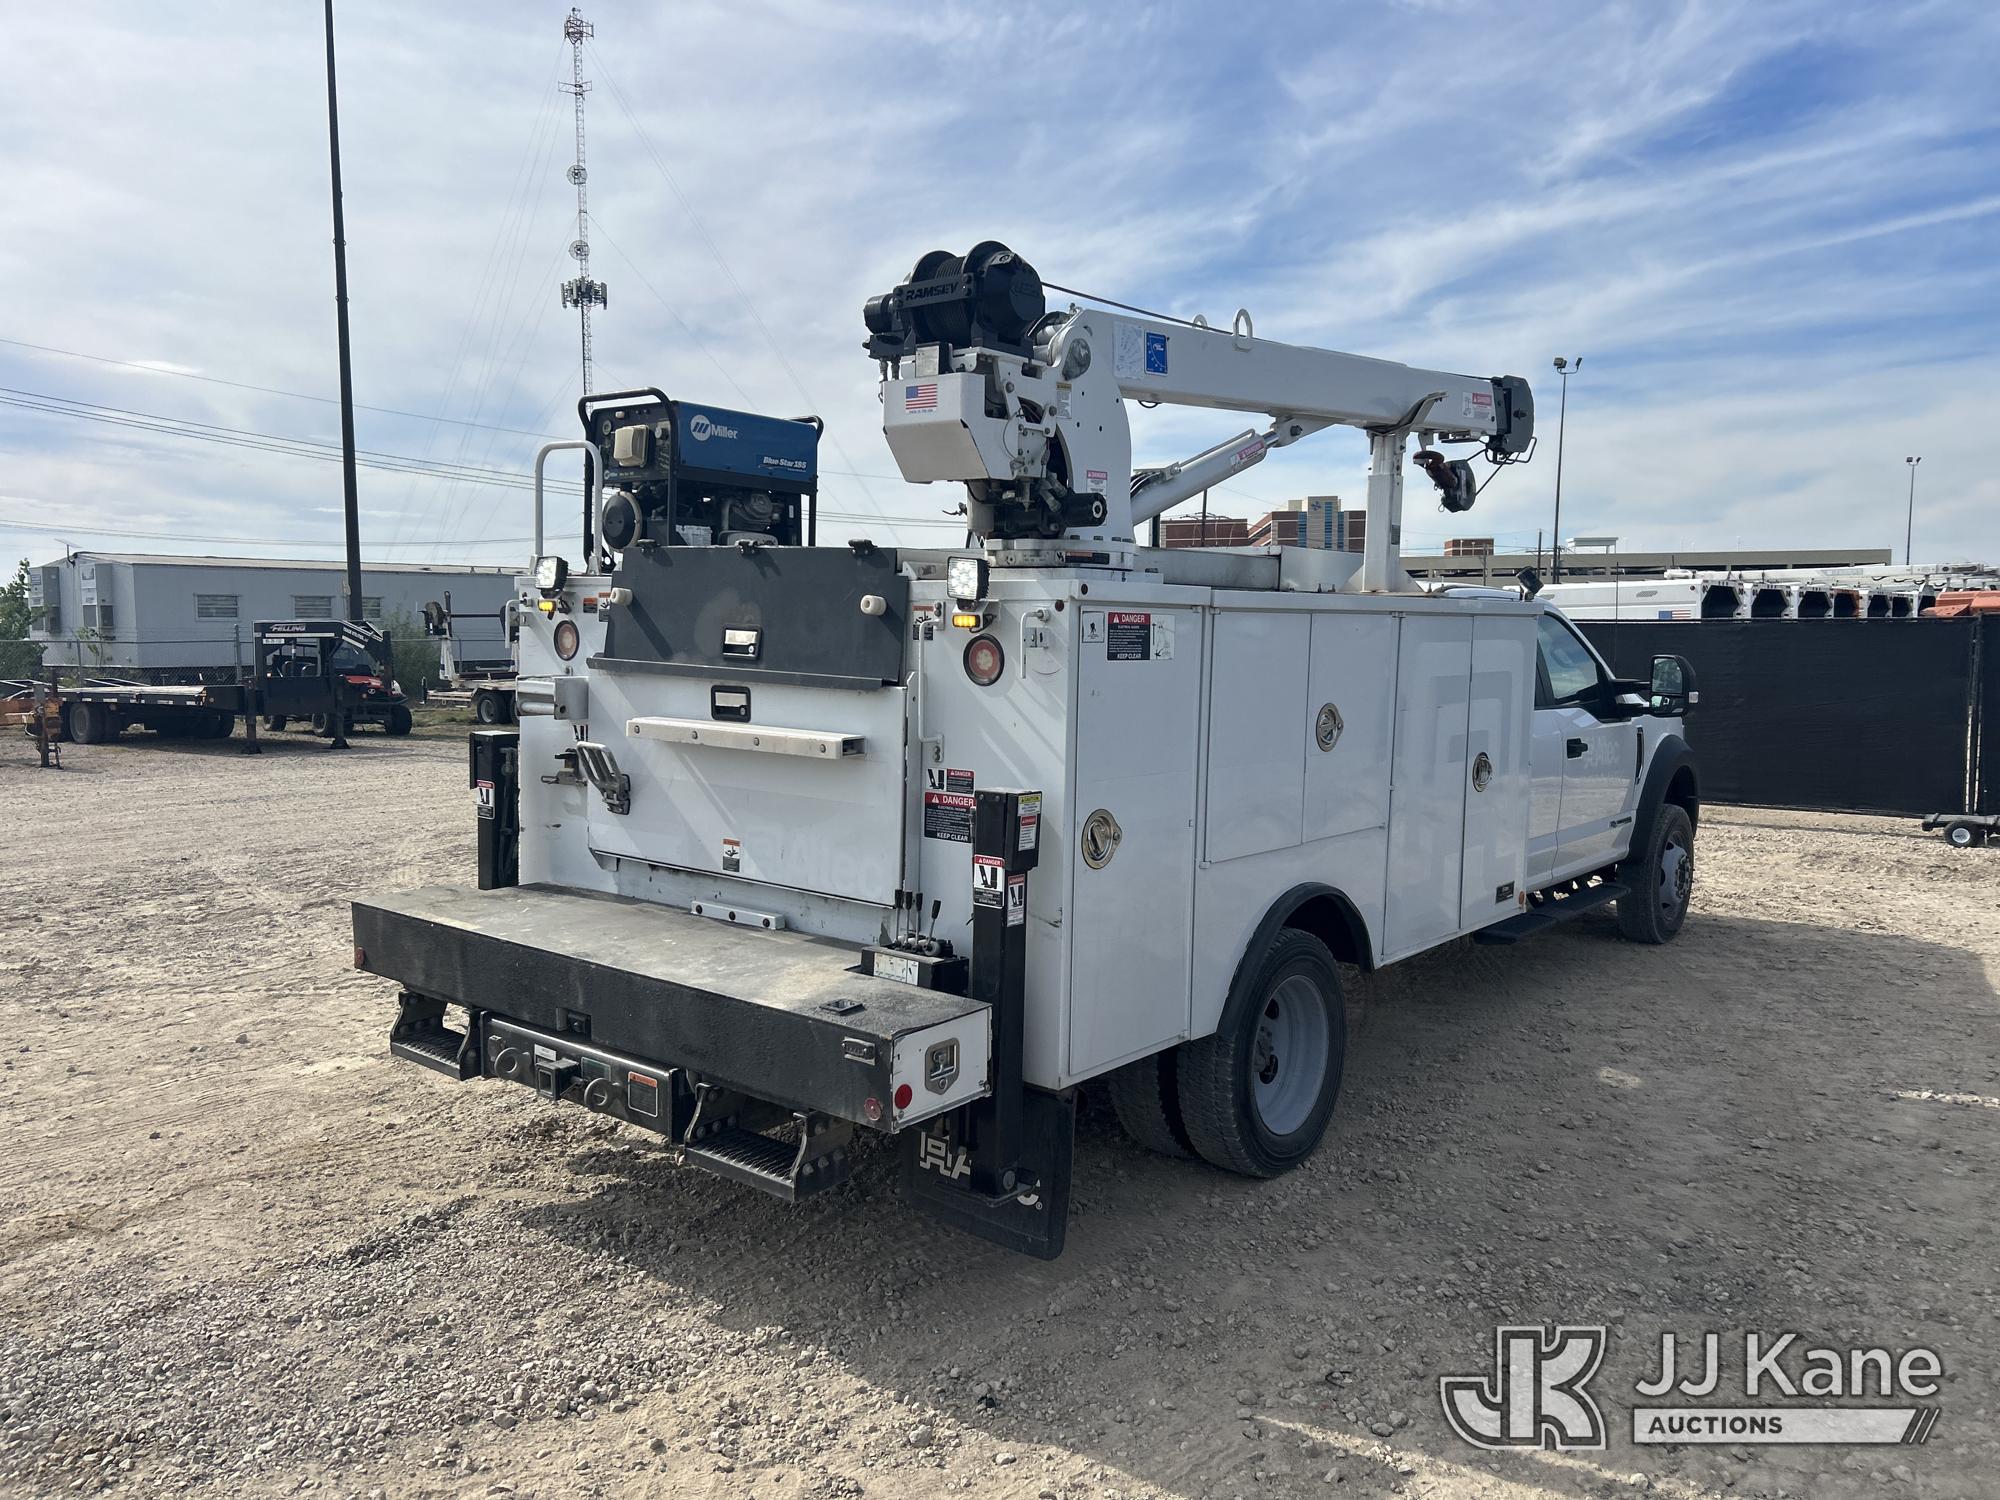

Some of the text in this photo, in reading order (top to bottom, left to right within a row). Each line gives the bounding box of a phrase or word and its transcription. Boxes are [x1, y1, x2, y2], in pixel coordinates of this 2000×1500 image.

[905, 282, 958, 300] RAMSEY
[711, 423, 739, 440] Miller
[763, 456, 779, 465] Blue
[779, 458, 795, 467] Star
[1121, 614, 1145, 623] DANGER
[942, 795, 974, 807] DANGER
[950, 833, 968, 841] CLEAR
[983, 858, 1001, 866] DANGER
